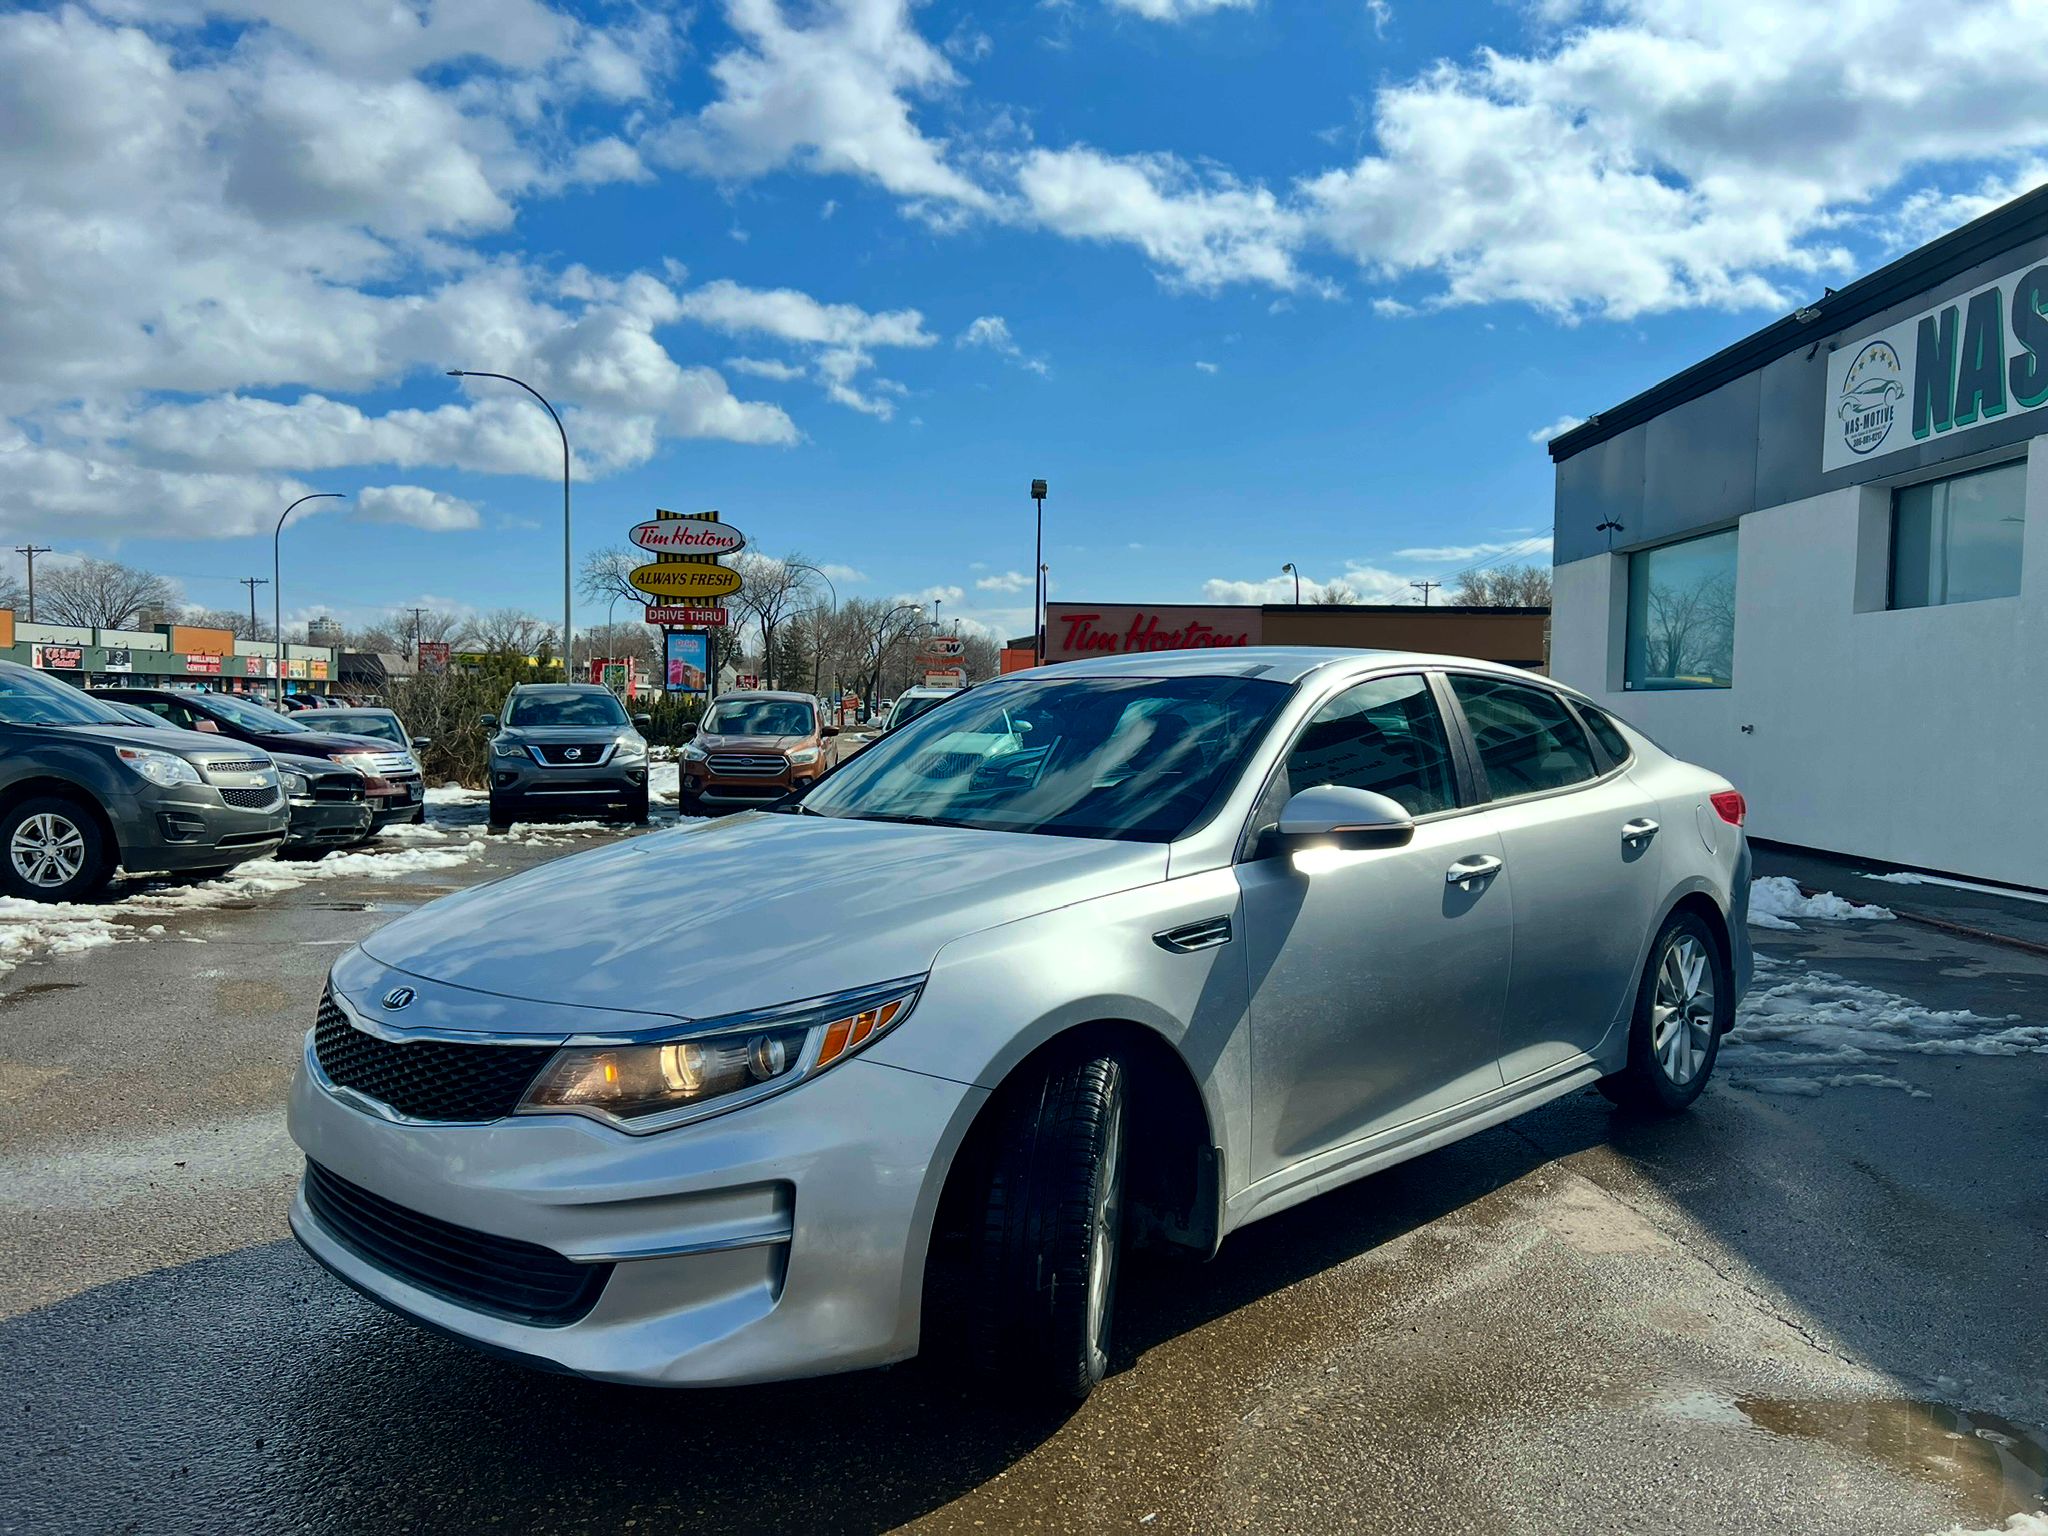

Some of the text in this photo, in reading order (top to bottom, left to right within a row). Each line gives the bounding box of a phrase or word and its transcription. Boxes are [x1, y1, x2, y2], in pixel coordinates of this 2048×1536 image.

[1844, 405, 1894, 436] NAS-MOTIVE
[638, 525, 734, 547] Tim Hortons
[636, 572, 734, 586] ALWAYS FRESH
[648, 609, 722, 622] DRIVE THRU
[1060, 613, 1249, 652] Tim Hortons
